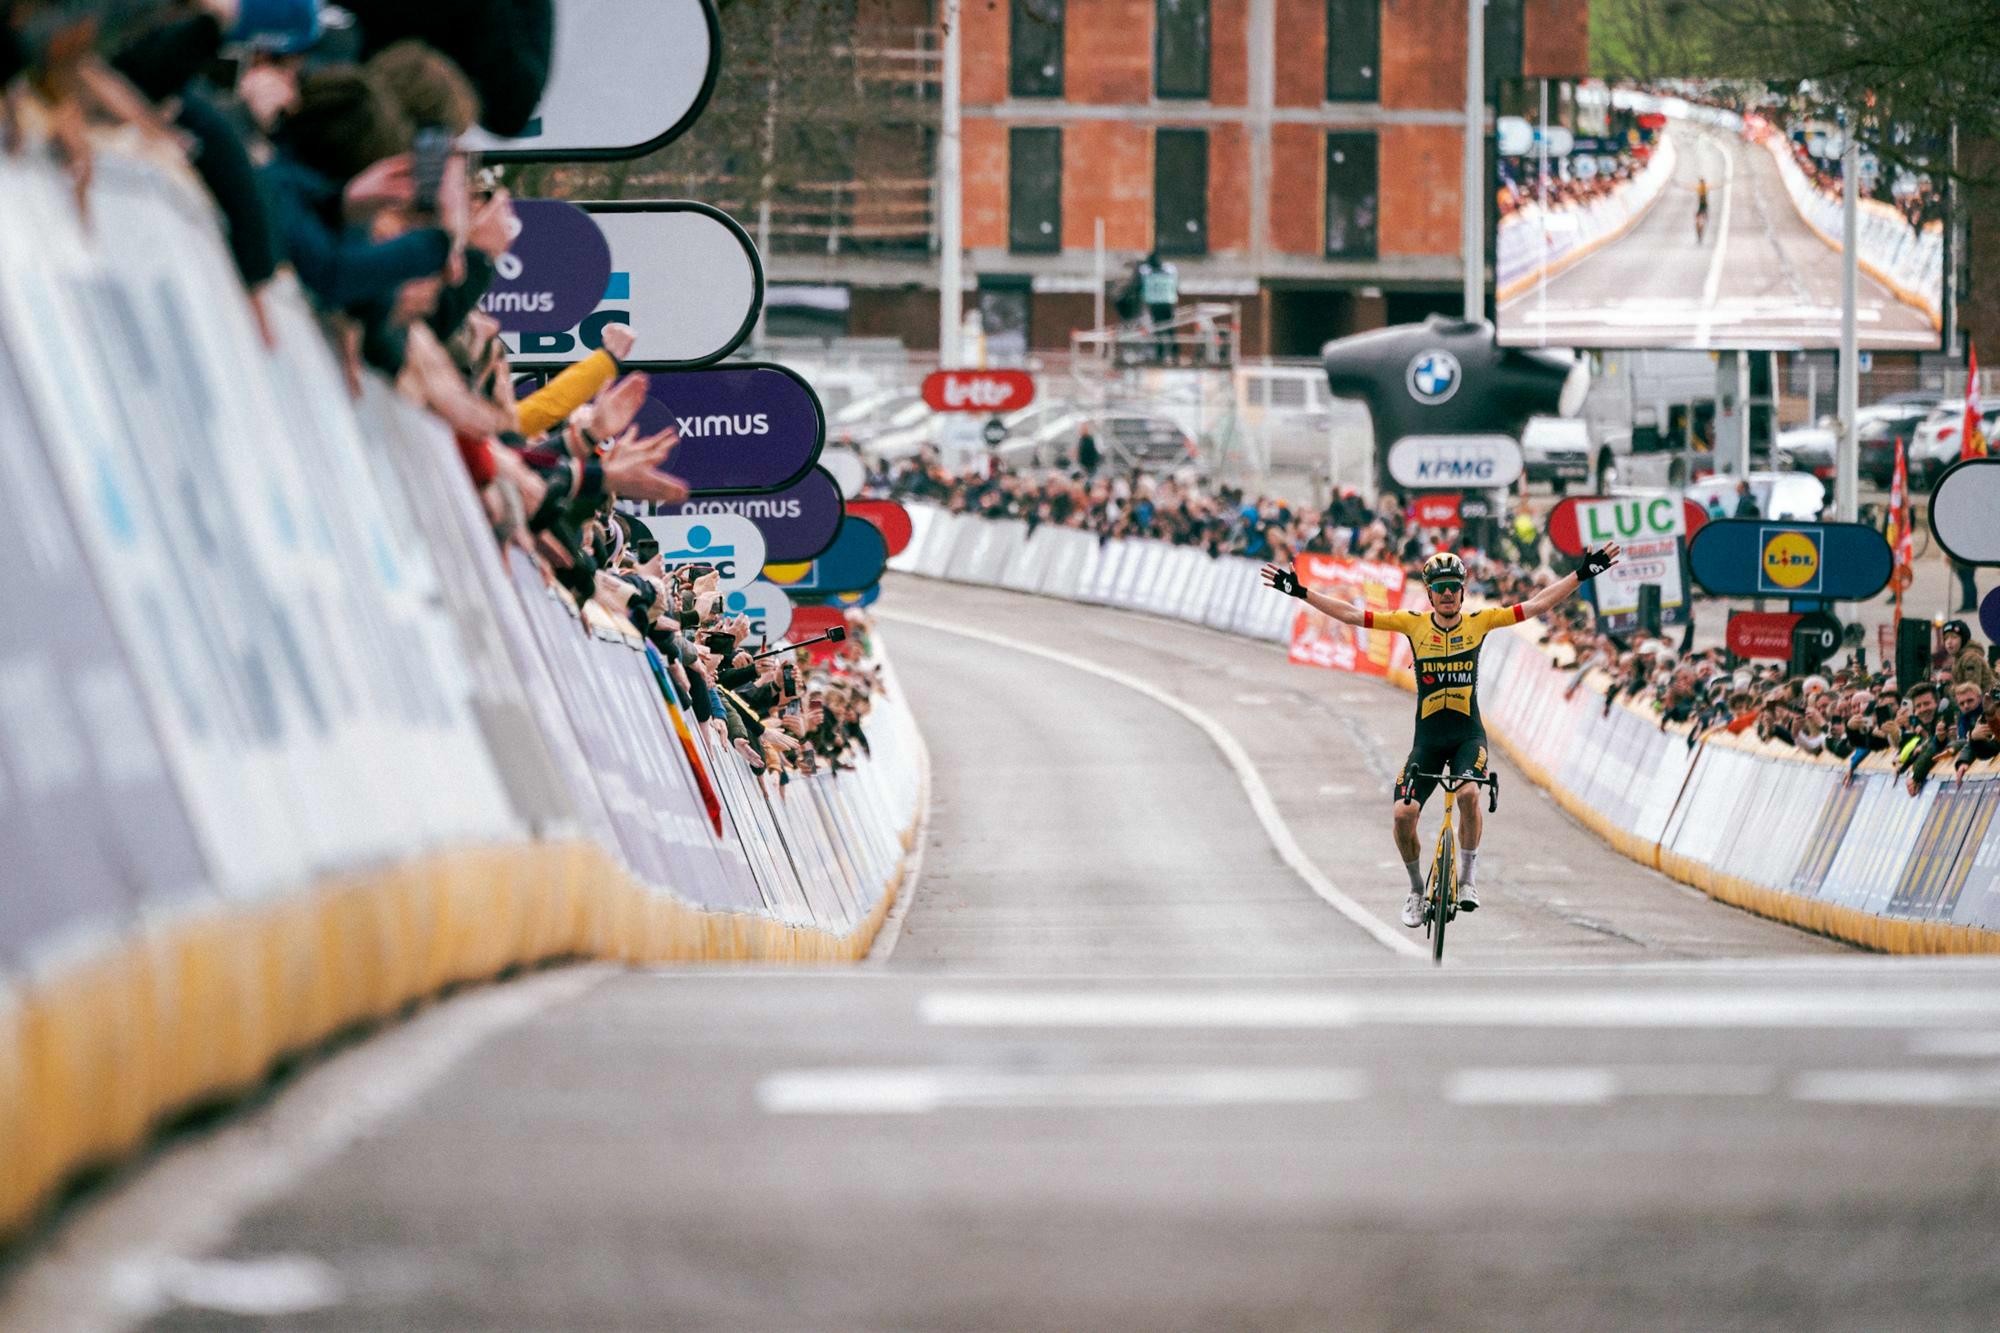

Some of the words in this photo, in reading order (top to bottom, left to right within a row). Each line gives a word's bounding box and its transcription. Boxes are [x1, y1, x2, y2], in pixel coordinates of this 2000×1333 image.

[477, 291, 555, 313] ximus
[497, 309, 630, 355] BC
[676, 413, 770, 437] ximus
[1417, 459, 1494, 479] KPMG
[1588, 498, 1675, 540] LUC
[1820, 629, 1835, 648] 0
[1422, 660, 1474, 673] JUMBO
[1437, 672, 1472, 683] VISMA
